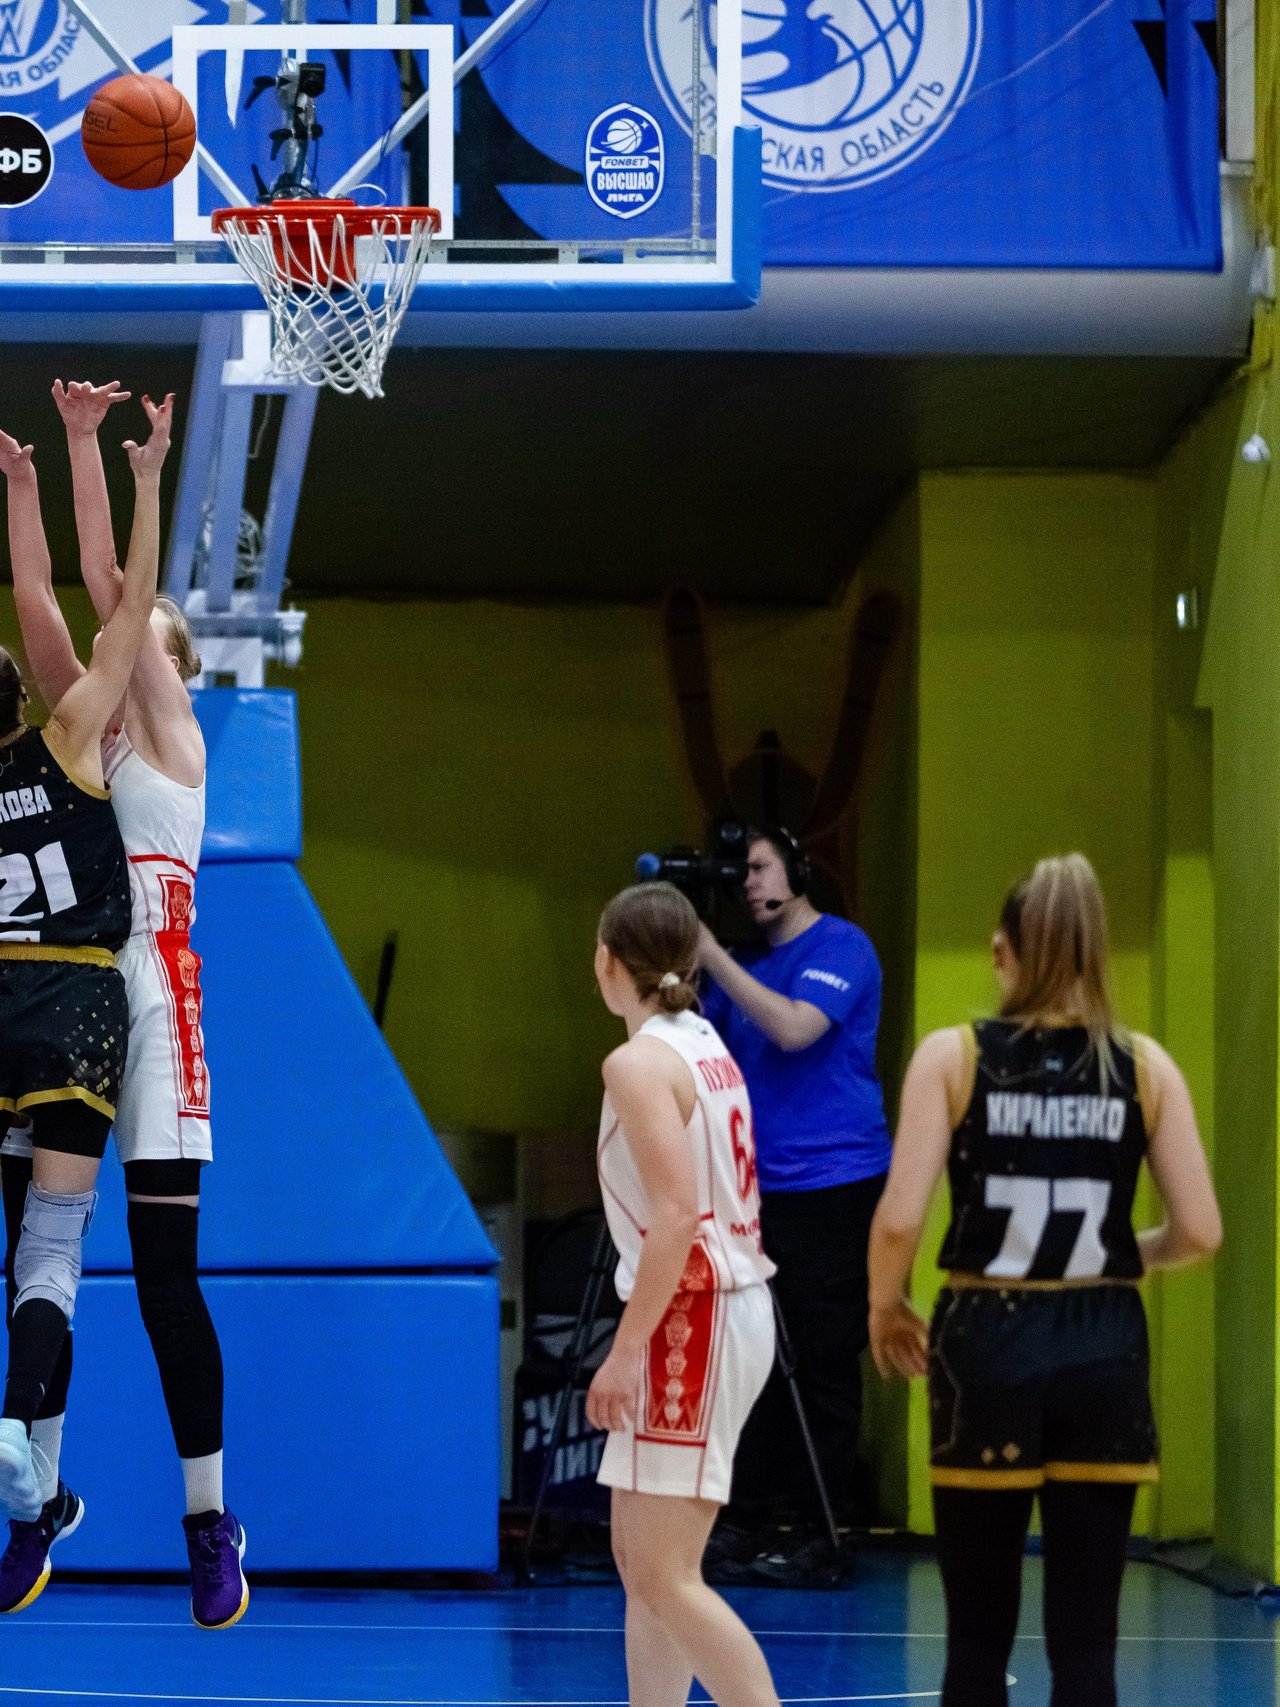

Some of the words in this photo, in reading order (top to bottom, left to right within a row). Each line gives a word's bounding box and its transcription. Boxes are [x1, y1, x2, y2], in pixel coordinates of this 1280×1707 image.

[841, 81, 945, 167] ОБЛАСТЬ
[604, 158, 646, 167] FONBET
[597, 172, 655, 191] ВЫСШАЯ
[606, 193, 645, 203] ЛИГА
[984, 1174, 1112, 1281] 77
